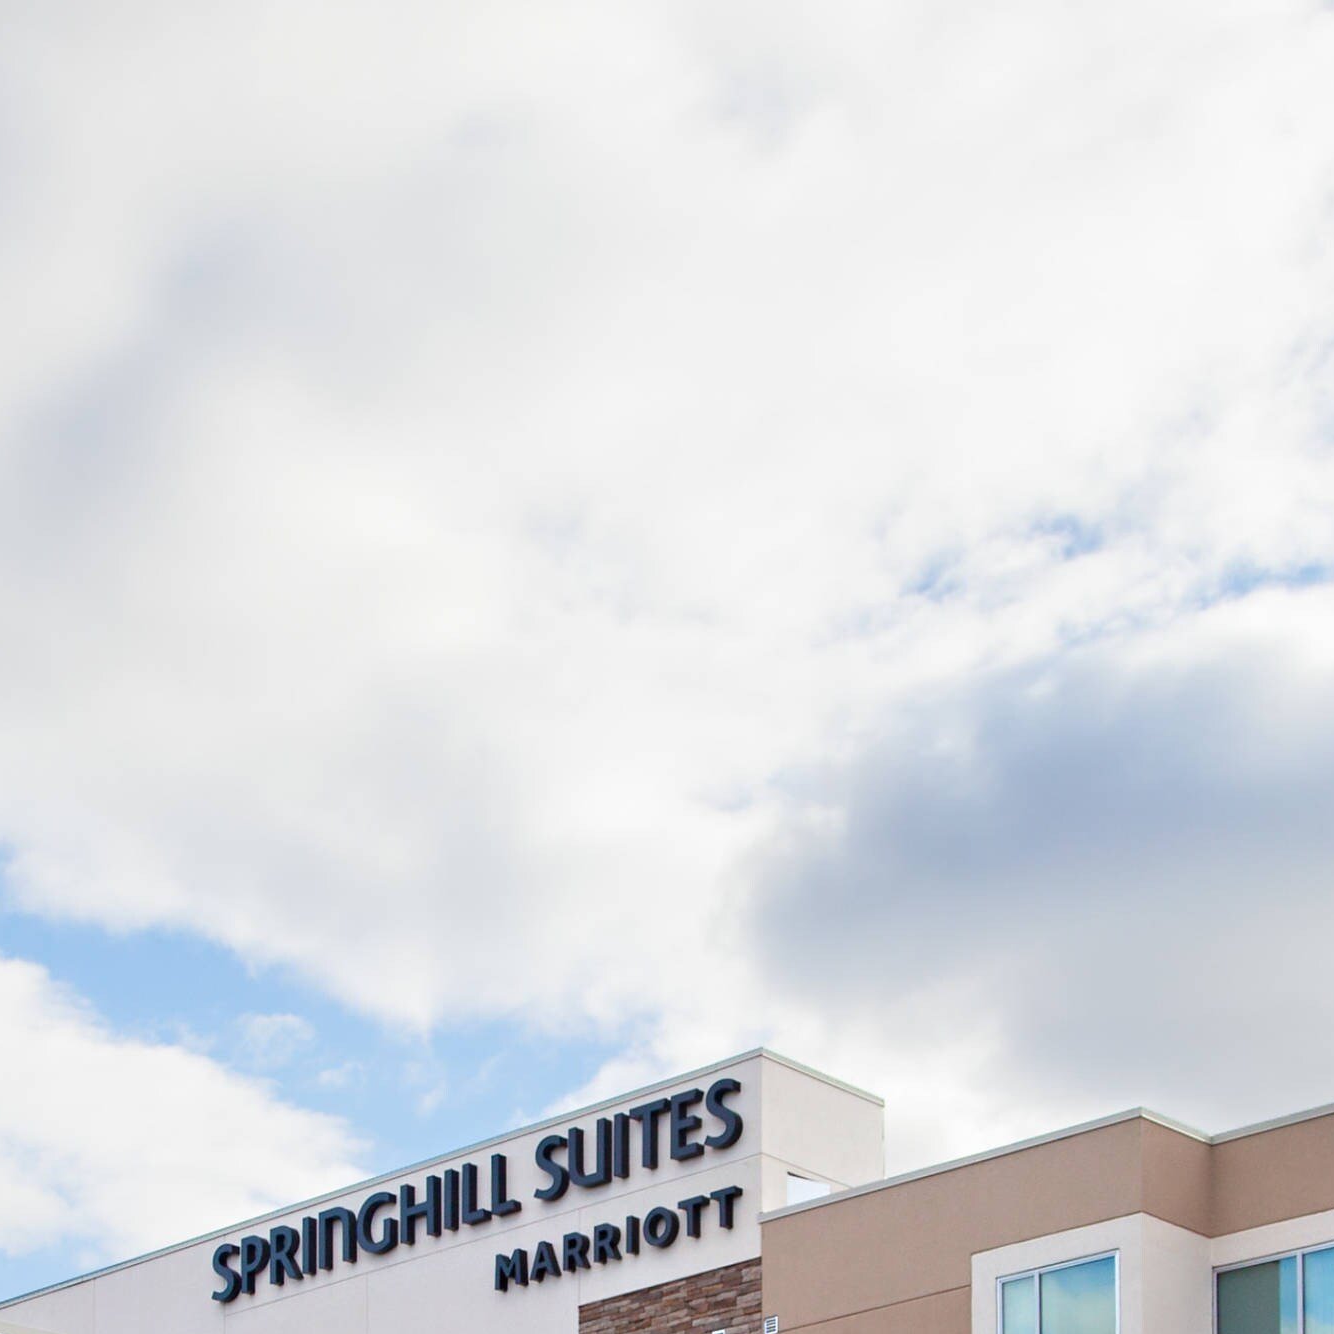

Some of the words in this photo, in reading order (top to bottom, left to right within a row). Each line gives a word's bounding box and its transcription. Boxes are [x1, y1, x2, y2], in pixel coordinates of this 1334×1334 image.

[212, 1153, 522, 1303] SPRINGHILL
[533, 1077, 743, 1202] SUITES
[495, 1185, 743, 1292] MARRIOTT
